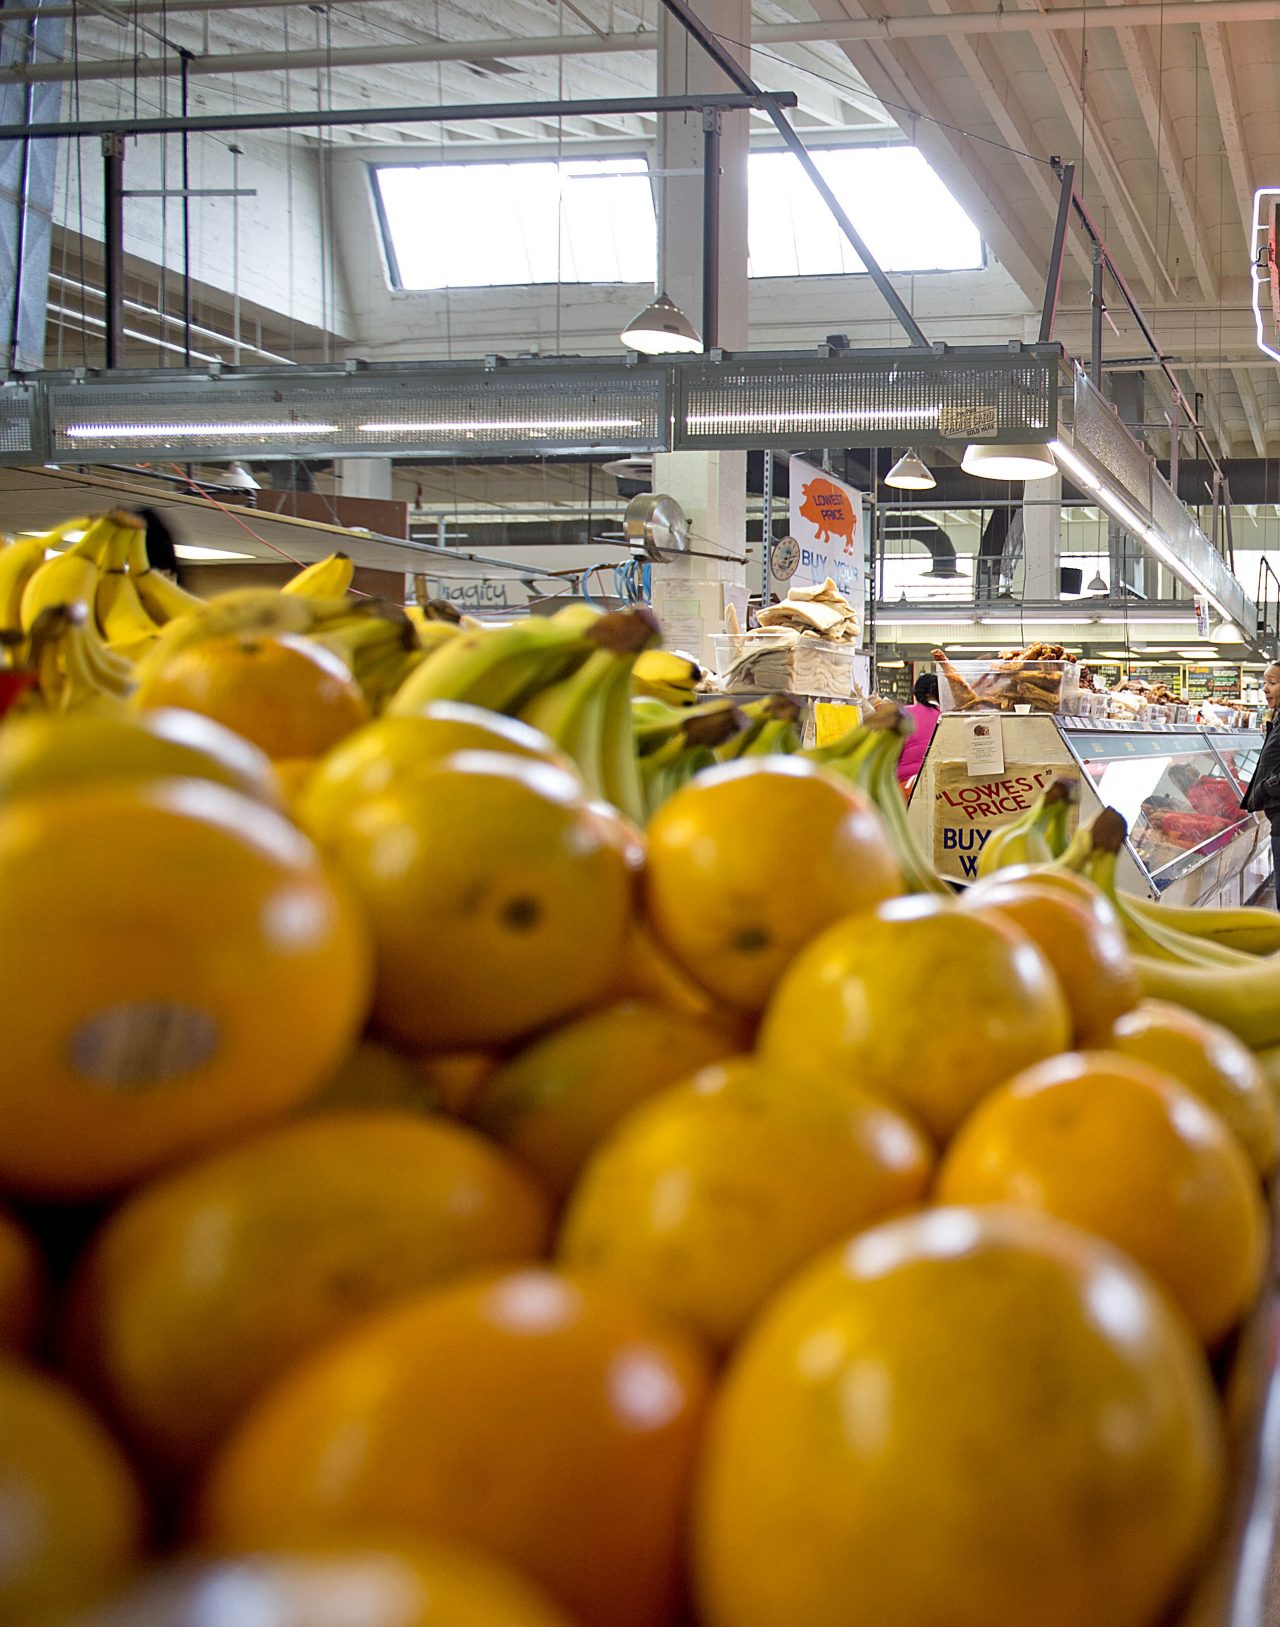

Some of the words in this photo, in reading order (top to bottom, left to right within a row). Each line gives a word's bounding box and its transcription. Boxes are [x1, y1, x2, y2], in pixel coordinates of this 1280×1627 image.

[966, 427, 980, 436] SOLD
[981, 423, 995, 433] HERE
[813, 494, 844, 506] LOWEST
[820, 509, 845, 520] PRICE
[802, 549, 827, 571] BUY
[834, 559, 858, 581] YOUR
[962, 795, 1031, 820] PRICE
[943, 828, 991, 851] BUY
